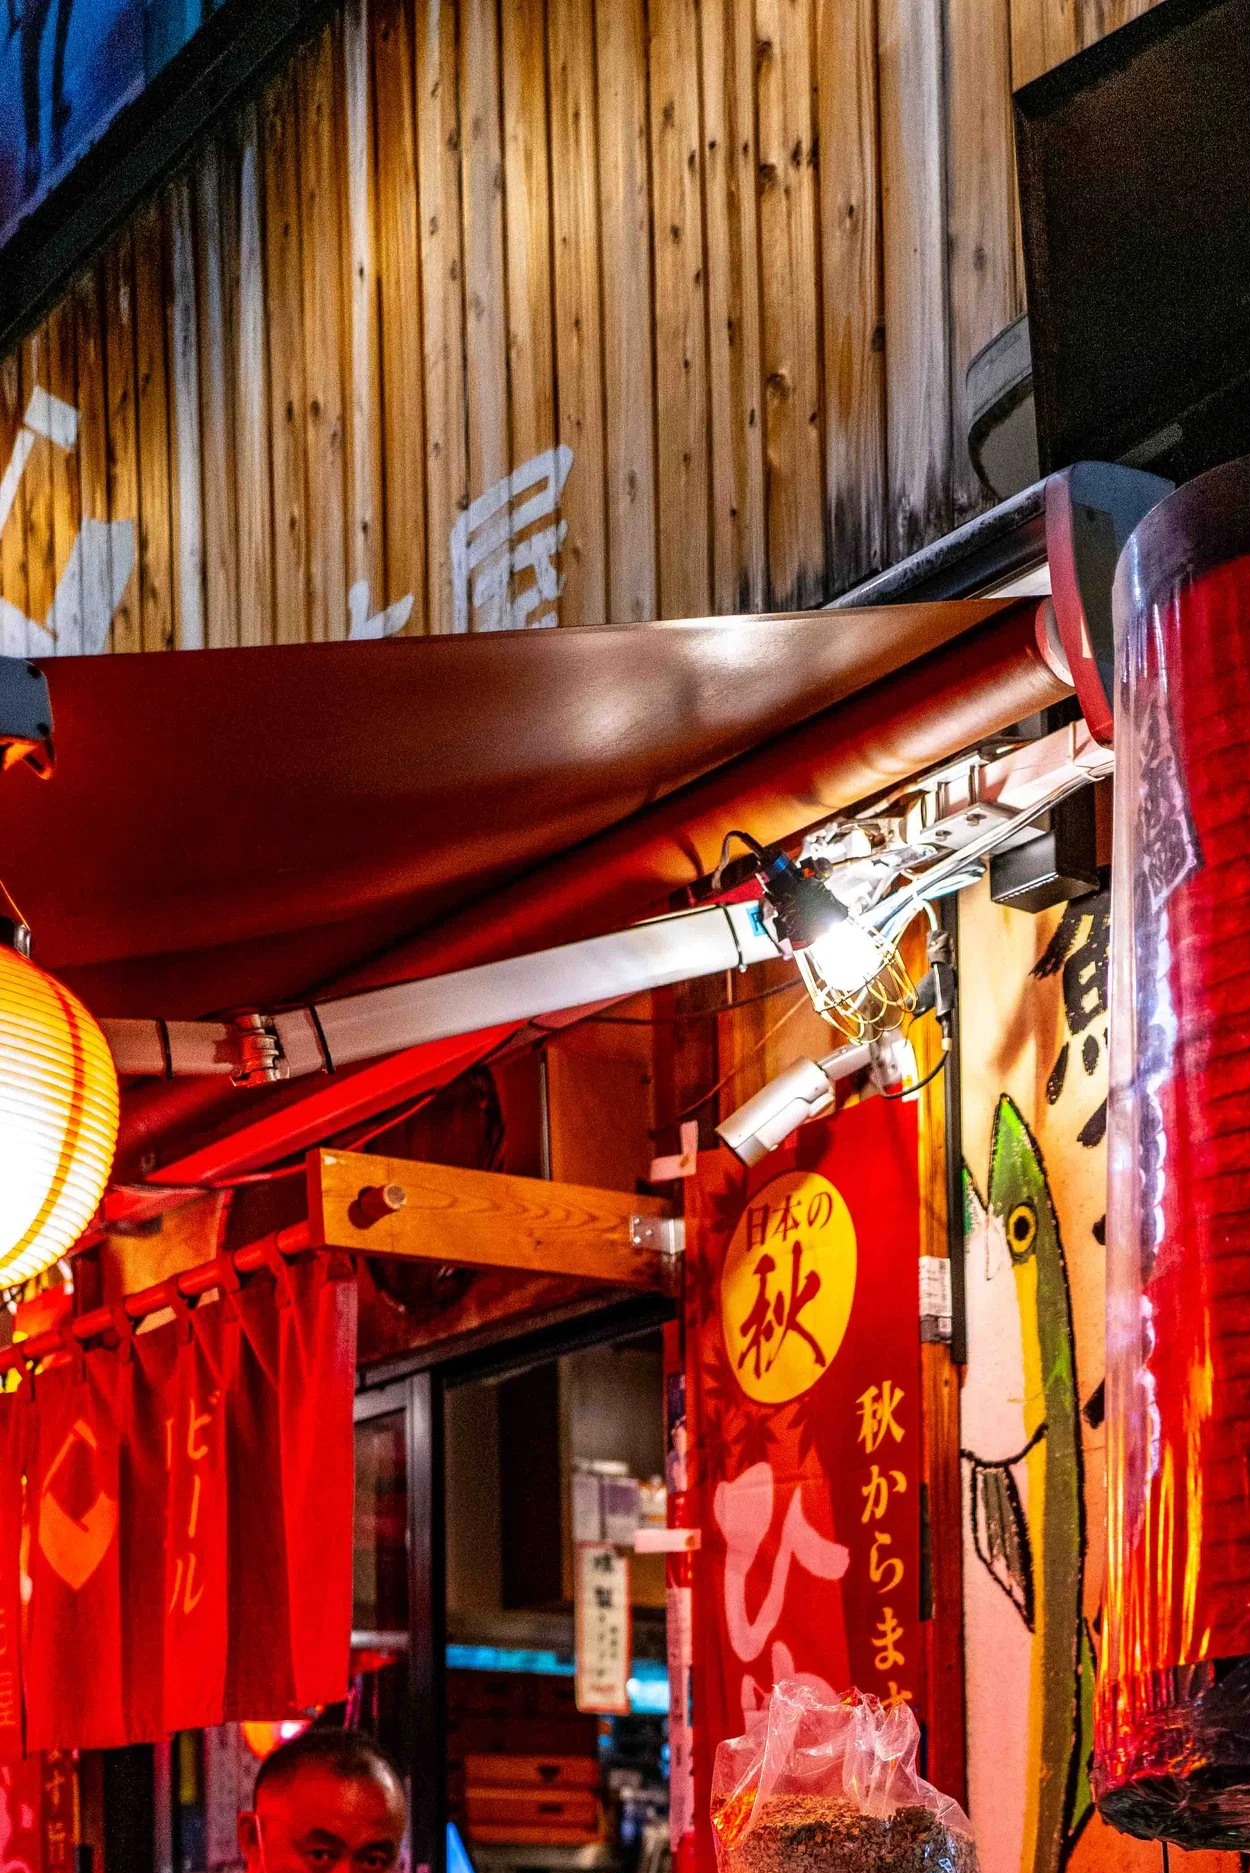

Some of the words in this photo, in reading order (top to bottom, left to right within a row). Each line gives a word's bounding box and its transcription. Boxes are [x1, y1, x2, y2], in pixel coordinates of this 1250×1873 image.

[744, 1189, 833, 1251] 日本の
[737, 1239, 829, 1378] 秋
